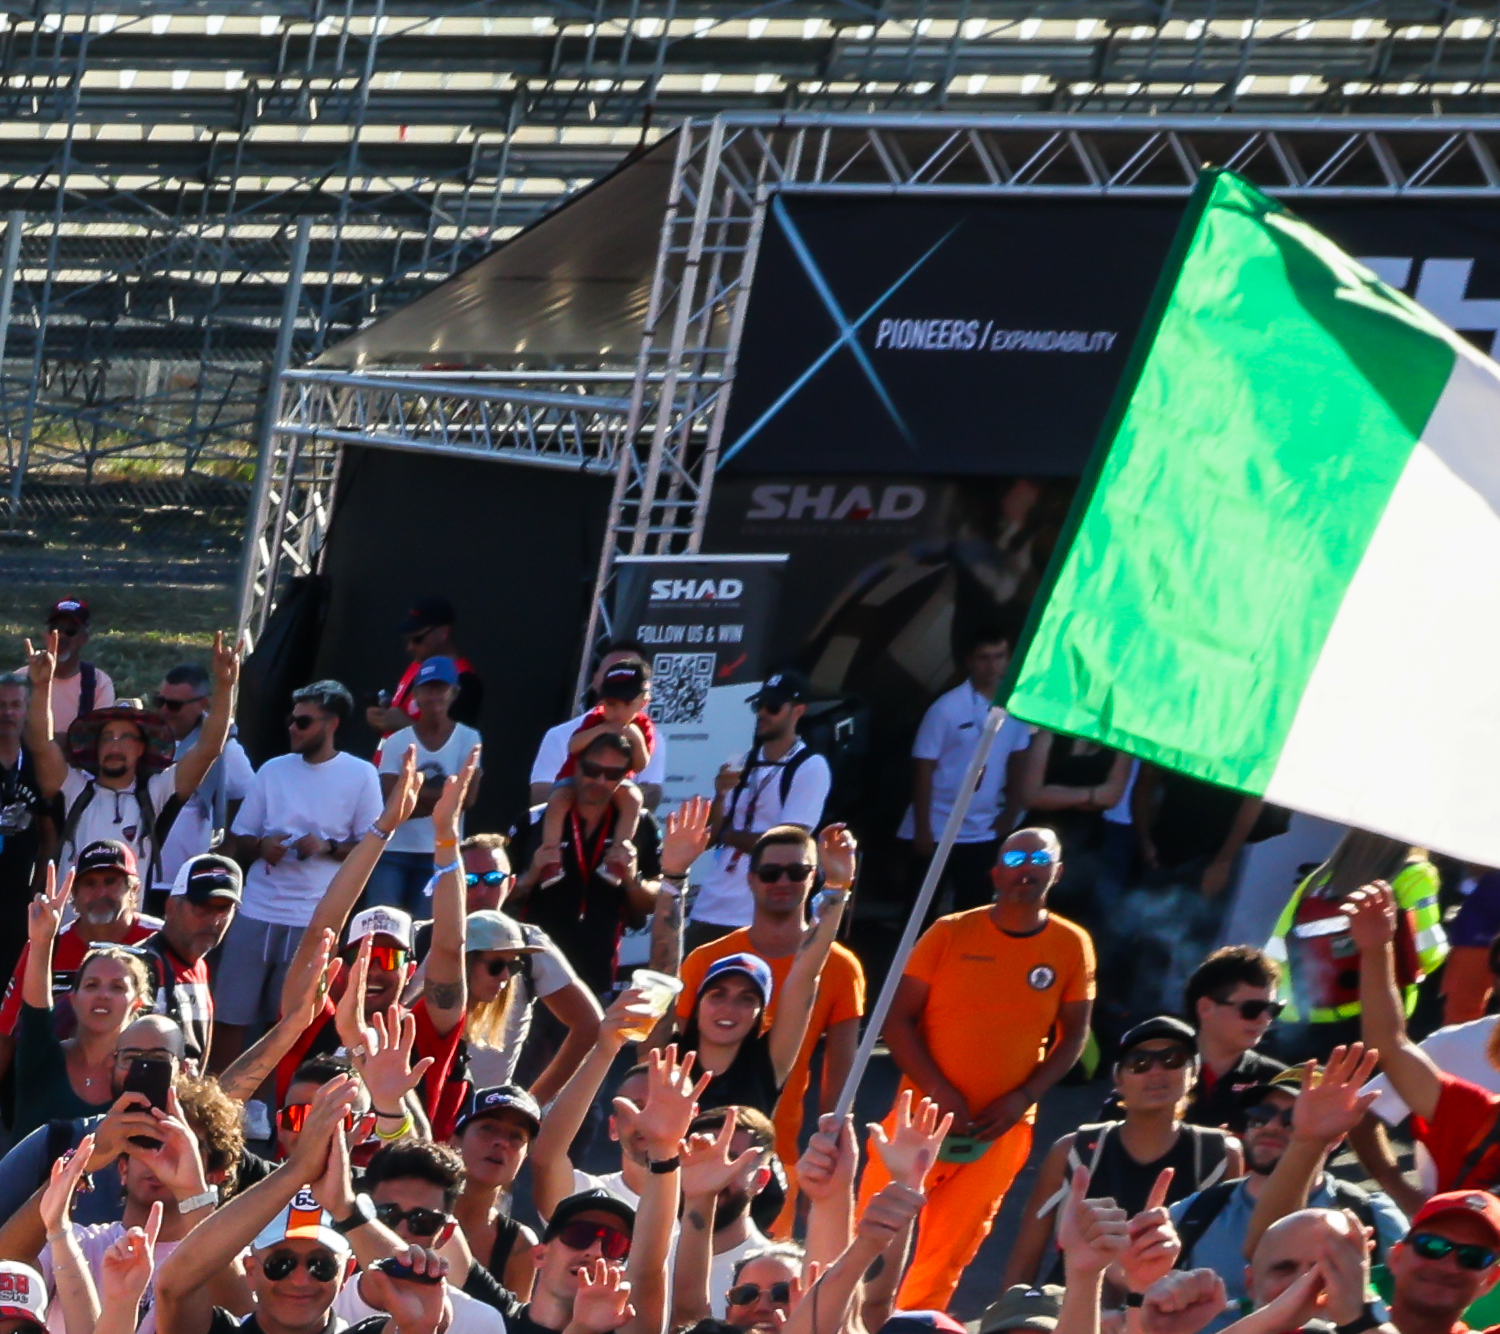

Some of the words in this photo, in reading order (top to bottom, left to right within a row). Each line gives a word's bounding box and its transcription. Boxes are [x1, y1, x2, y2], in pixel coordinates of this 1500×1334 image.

[876, 318, 978, 351] PIONEERS
[746, 484, 926, 522] SHAD
[650, 579, 744, 600] SHAD
